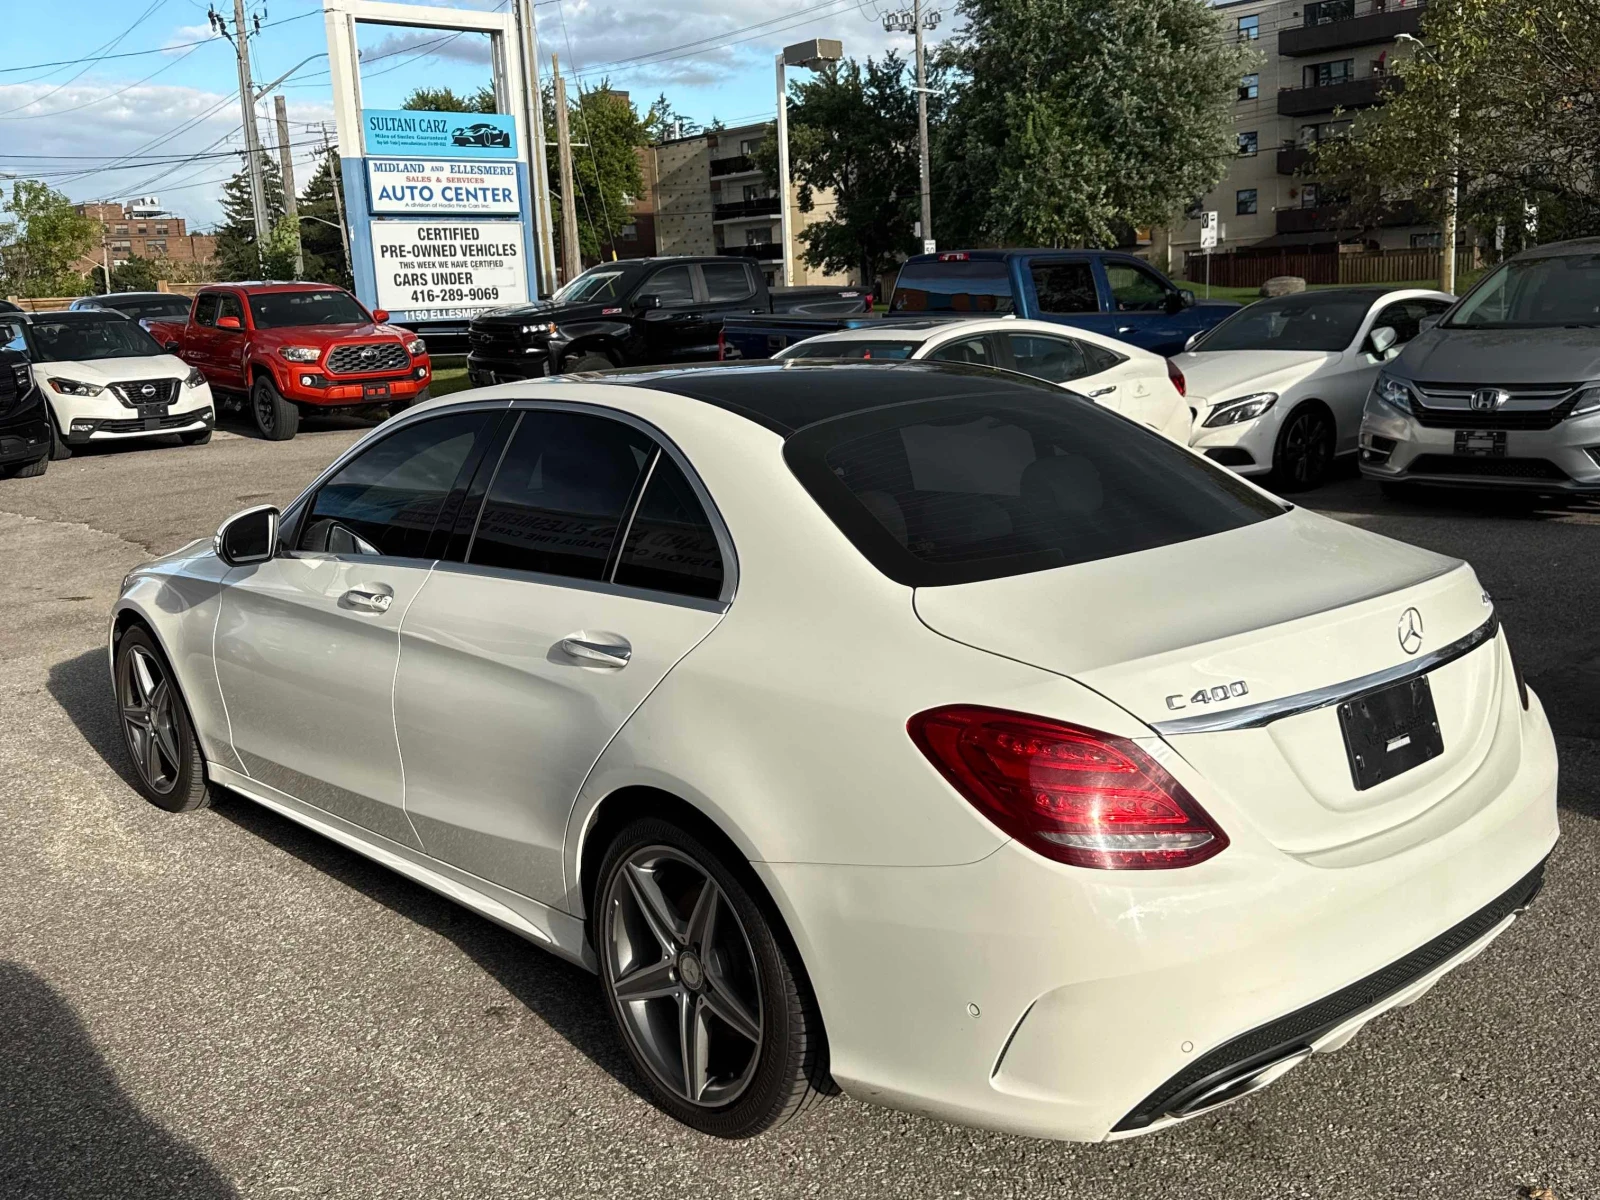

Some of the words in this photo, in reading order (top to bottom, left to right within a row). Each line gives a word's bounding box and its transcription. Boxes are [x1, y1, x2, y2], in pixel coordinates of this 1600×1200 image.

[370, 117, 416, 132] SULTANI
[419, 119, 447, 133] CARZ
[373, 163, 425, 173] MIDLAND
[450, 165, 514, 175] ELLESMERE
[446, 176, 485, 184] SERVICES
[378, 185, 434, 201] AUTO
[441, 186, 514, 203] CENTER
[417, 227, 480, 241] CERTIFIED
[380, 244, 457, 258] PRE-OWNED
[460, 243, 517, 257] VEHICLES
[399, 261, 415, 269] THIS
[416, 261, 437, 269] WEEK
[437, 261, 449, 269] WE
[451, 260, 468, 268] HAVE
[470, 260, 504, 268] CERTIFIED
[393, 273, 428, 287] CARS
[431, 272, 474, 285] UNDER
[411, 287, 499, 303] 416-289-9069
[404, 310, 428, 320] 1150
[430, 308, 490, 319] ELLESME
[1165, 694, 1187, 710] C
[1190, 680, 1249, 704] 400
